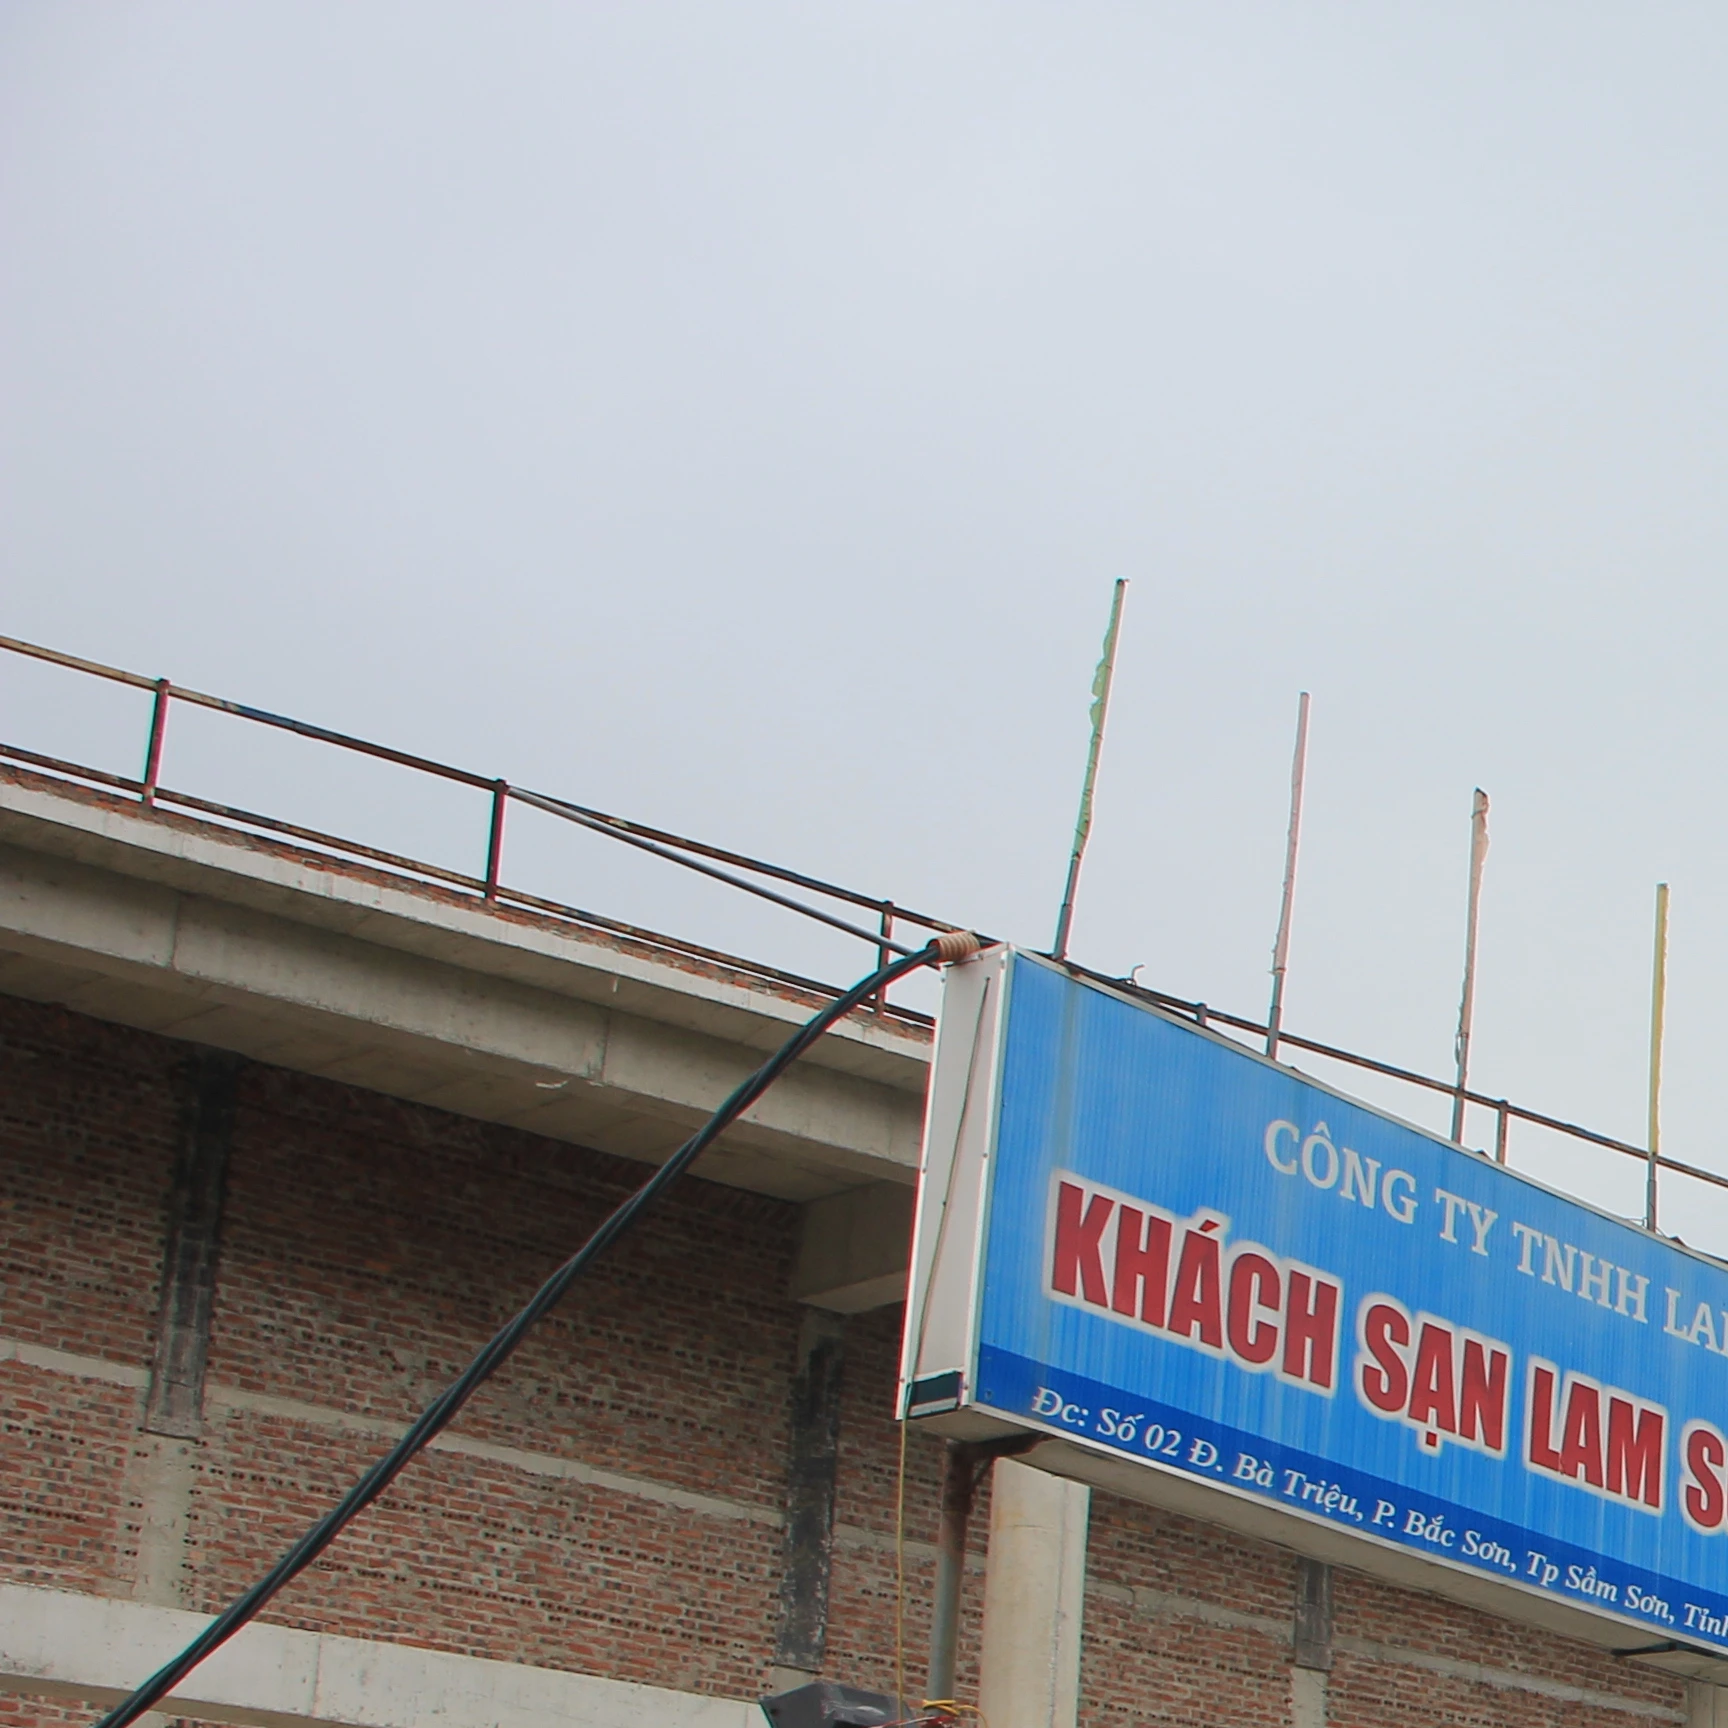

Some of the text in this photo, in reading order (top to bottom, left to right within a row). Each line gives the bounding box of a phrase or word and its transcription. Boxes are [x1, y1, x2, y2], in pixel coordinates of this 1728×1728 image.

[1264, 1120, 1419, 1225] CÔNG
[1436, 1189, 1498, 1256] TY
[1512, 1221, 1650, 1322] TNHH
[1051, 1180, 1338, 1388] KHÁCH
[1361, 1304, 1508, 1452] SẠN
[1530, 1368, 1666, 1508] LAM
[1031, 1386, 1088, 1427] Đc:
[1096, 1409, 1145, 1444] Số
[1144, 1425, 1180, 1458] 02
[1189, 1438, 1225, 1472] Đ.
[1232, 1453, 1275, 1488] Bà
[1282, 1469, 1365, 1521] Triệu,
[1372, 1500, 1397, 1529] P.
[1404, 1502, 1455, 1547] Bắc
[1461, 1531, 1518, 1575] Sơn,
[1525, 1551, 1560, 1588] Tp
[1564, 1555, 1619, 1601] Sầm
[1625, 1585, 1675, 1628] Sơn,
